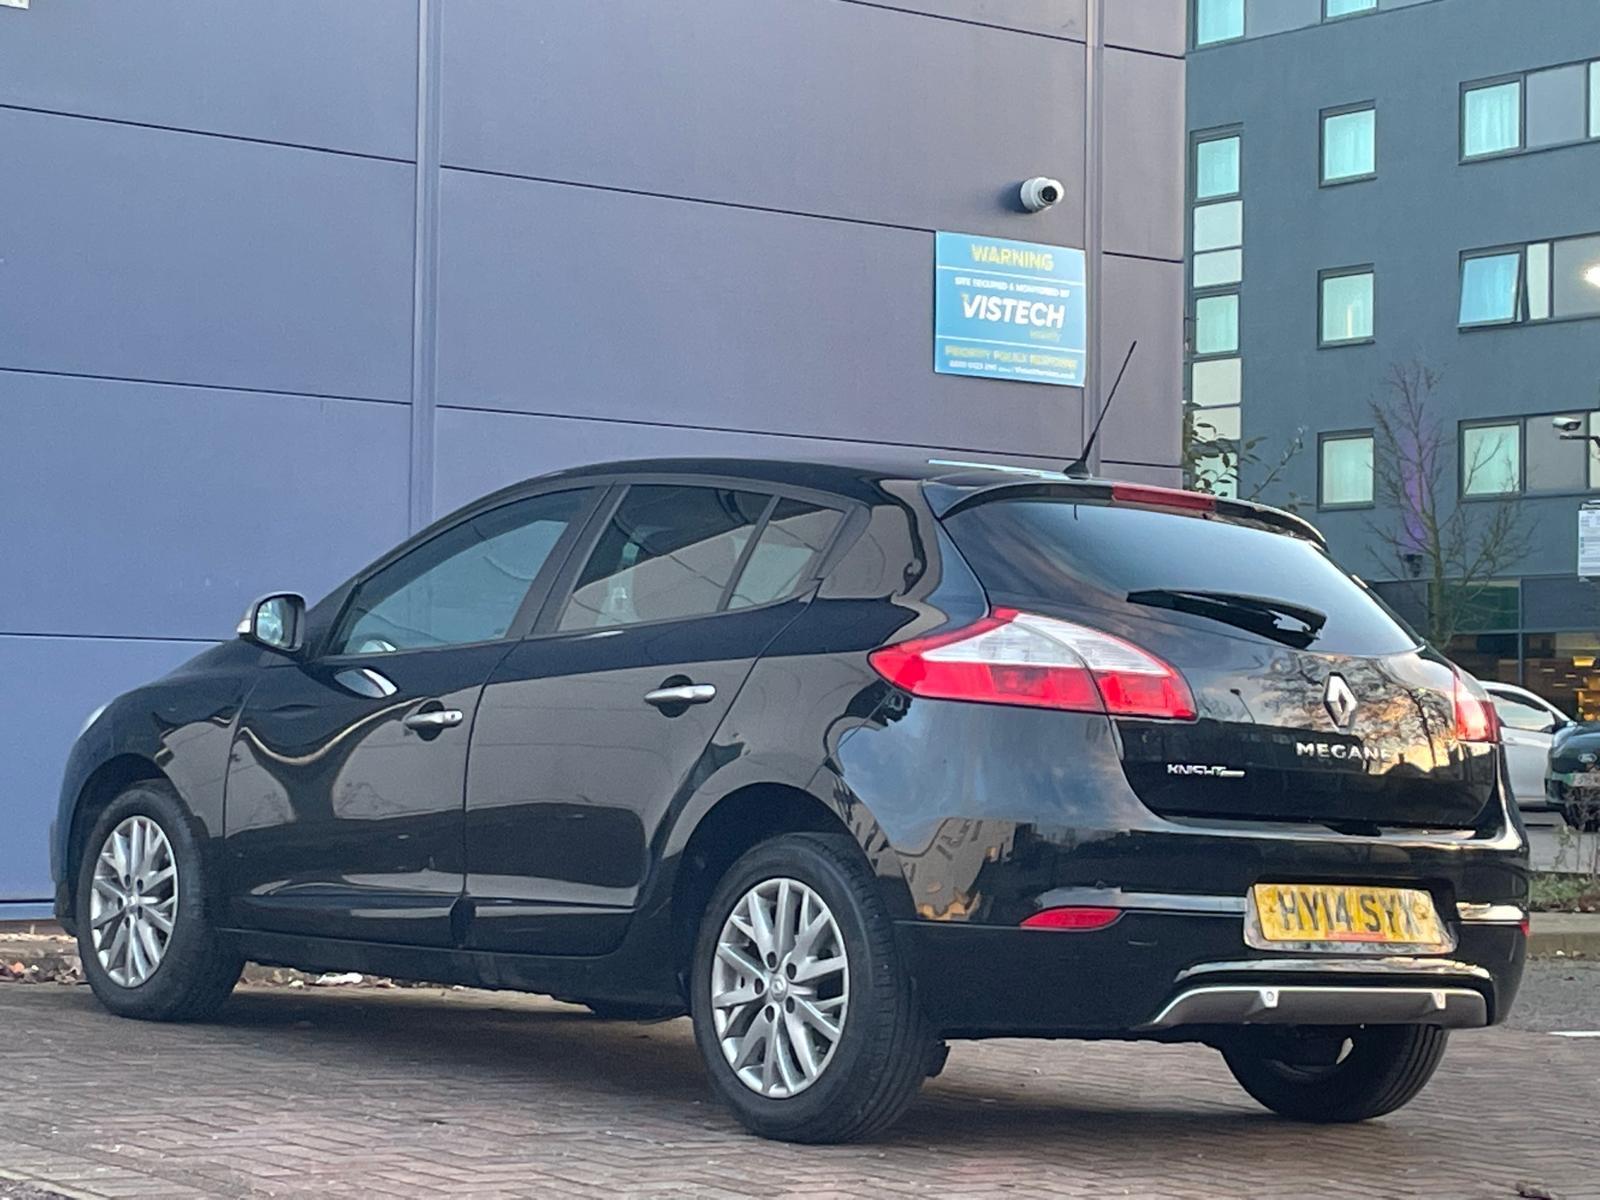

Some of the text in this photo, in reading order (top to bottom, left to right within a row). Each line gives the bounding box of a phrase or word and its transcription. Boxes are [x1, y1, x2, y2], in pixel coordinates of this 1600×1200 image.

[971, 244, 1054, 272] WARNING
[962, 294, 1065, 329] VISTECH
[1295, 742, 1392, 761] MEGANE
